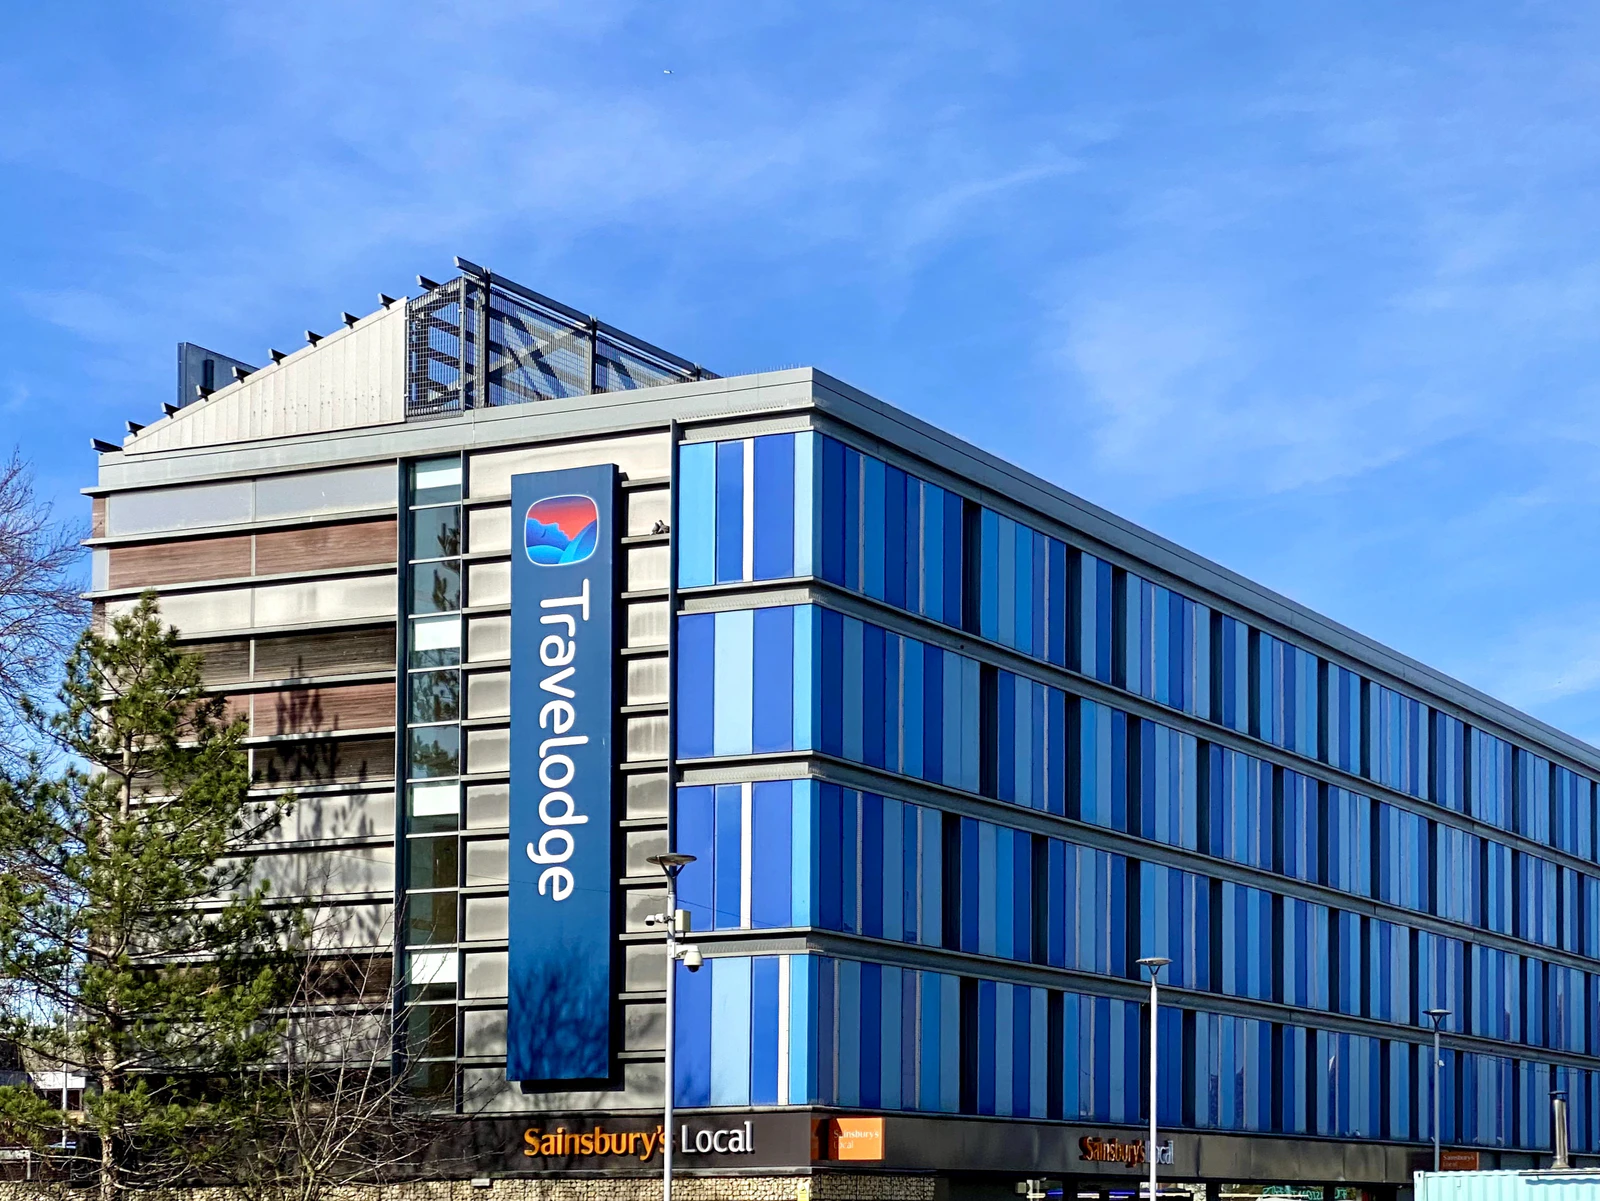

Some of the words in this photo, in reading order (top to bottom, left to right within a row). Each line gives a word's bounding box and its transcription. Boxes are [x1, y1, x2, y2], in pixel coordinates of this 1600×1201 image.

[526, 578, 590, 902] Travelodge
[681, 1121, 755, 1154] Local
[1082, 1136, 1145, 1167] Sainsbury's
